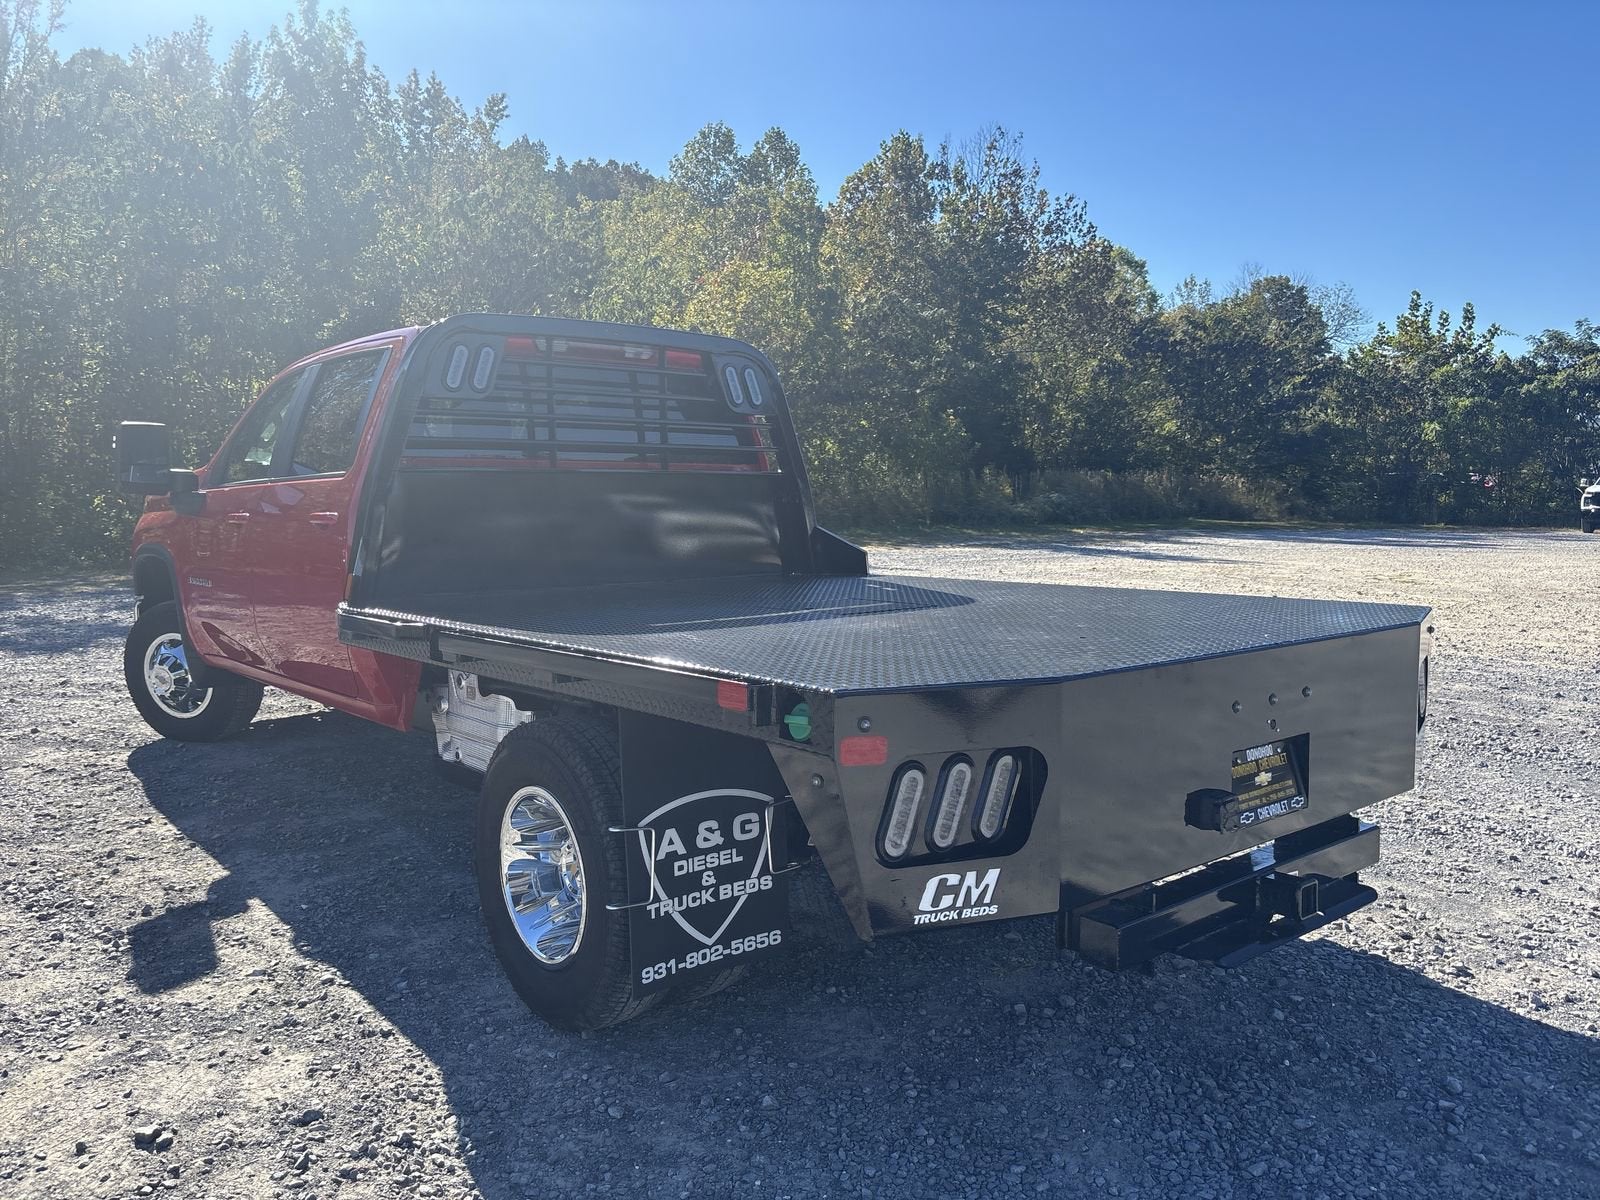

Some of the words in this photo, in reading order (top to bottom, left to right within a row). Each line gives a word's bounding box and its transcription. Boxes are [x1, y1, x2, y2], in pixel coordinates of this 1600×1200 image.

[1257, 800, 1289, 819] CHEVROLET
[656, 828, 687, 861] A
[696, 819, 724, 848] &
[732, 812, 760, 841] G
[673, 848, 743, 877] DIESEL
[702, 870, 717, 886] &
[646, 888, 716, 919] TRUCK
[719, 875, 773, 901] BEDS
[918, 868, 1001, 912] CM
[913, 909, 960, 925] TRUCK
[961, 904, 999, 919] BEDS
[641, 929, 782, 985] 931-802-5656
